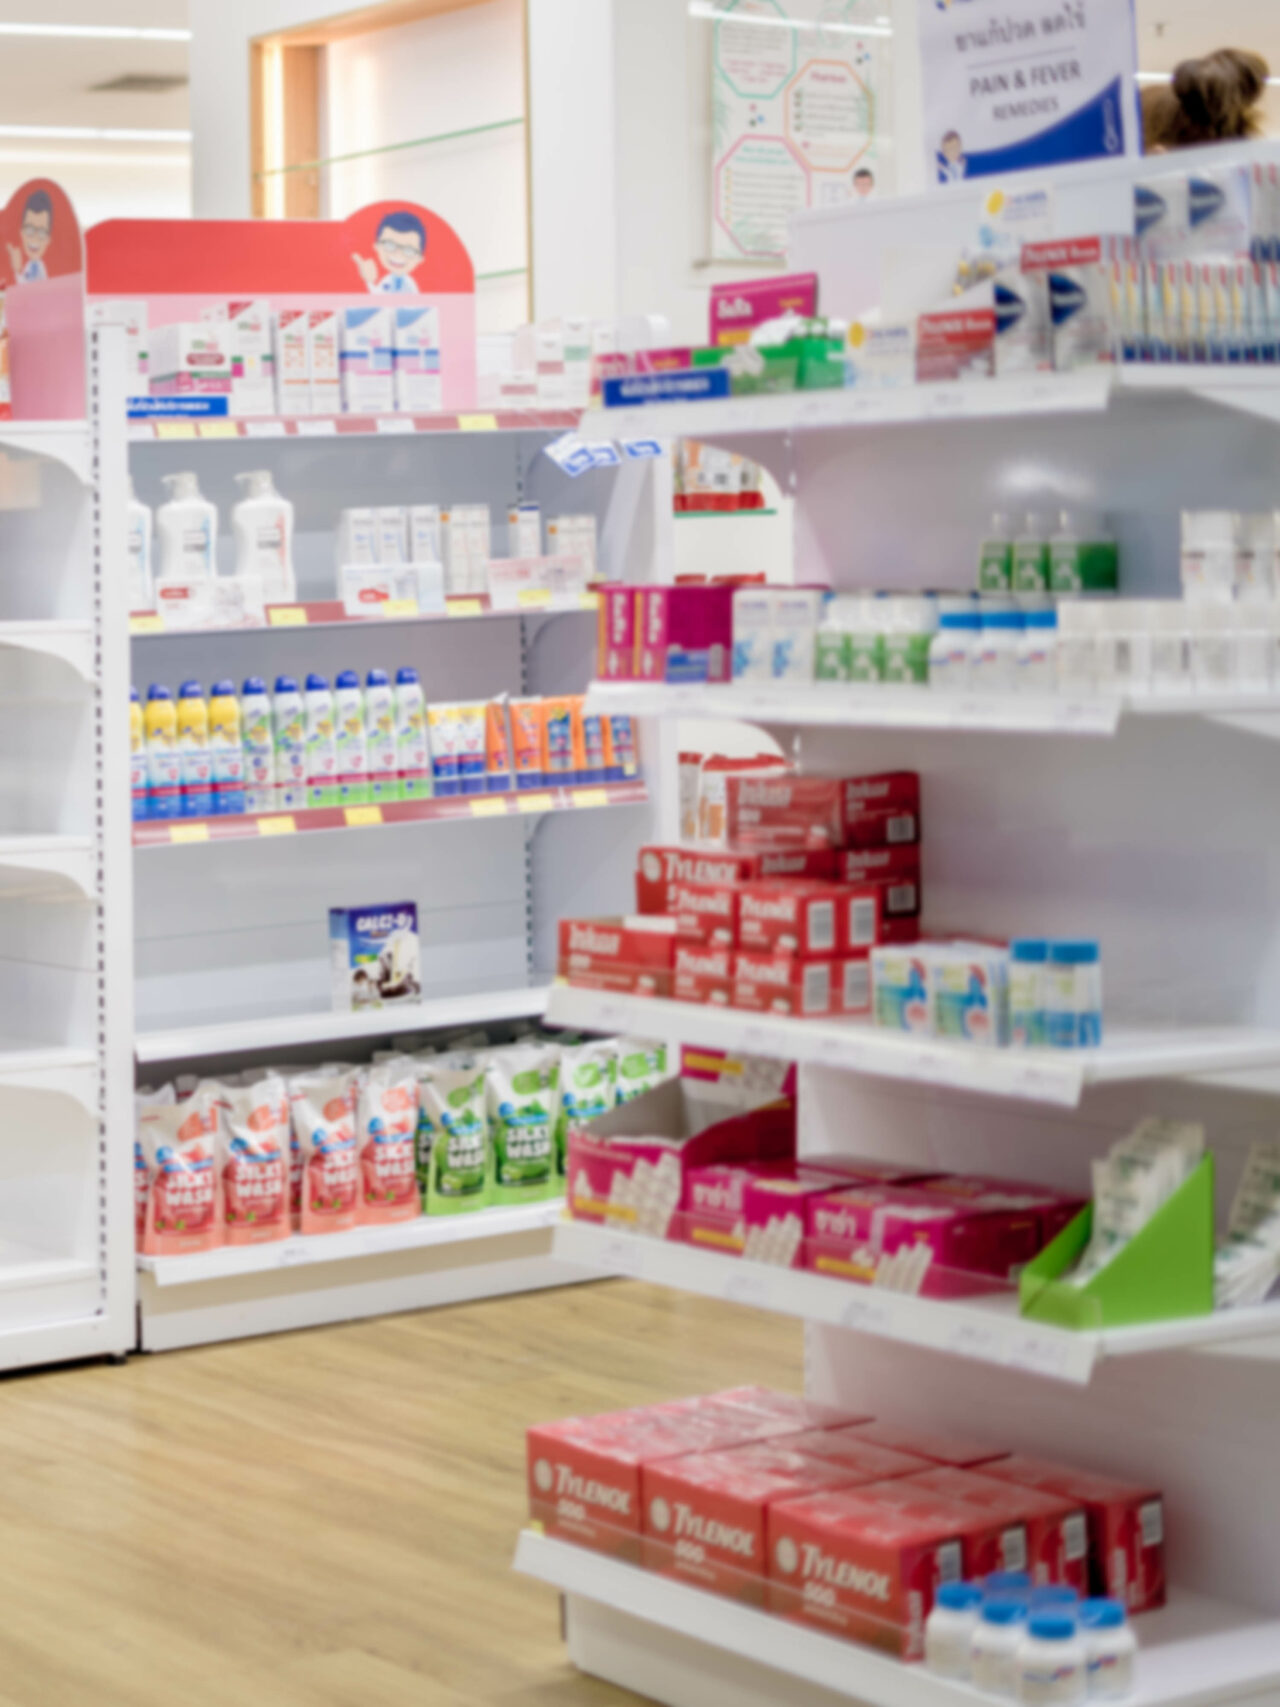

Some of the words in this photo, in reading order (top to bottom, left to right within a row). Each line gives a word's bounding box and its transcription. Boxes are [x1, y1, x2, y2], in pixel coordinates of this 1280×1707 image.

[969, 73, 1009, 98] PAIN
[1014, 69, 1027, 89] &
[1031, 59, 1081, 85] FEVER
[992, 96, 1060, 120] REMEDIES
[664, 853, 737, 888] TYLENOL
[554, 1462, 631, 1516] TYLENOL
[673, 1502, 756, 1558] TYLENOL
[801, 1542, 891, 1602] TYLENOL
